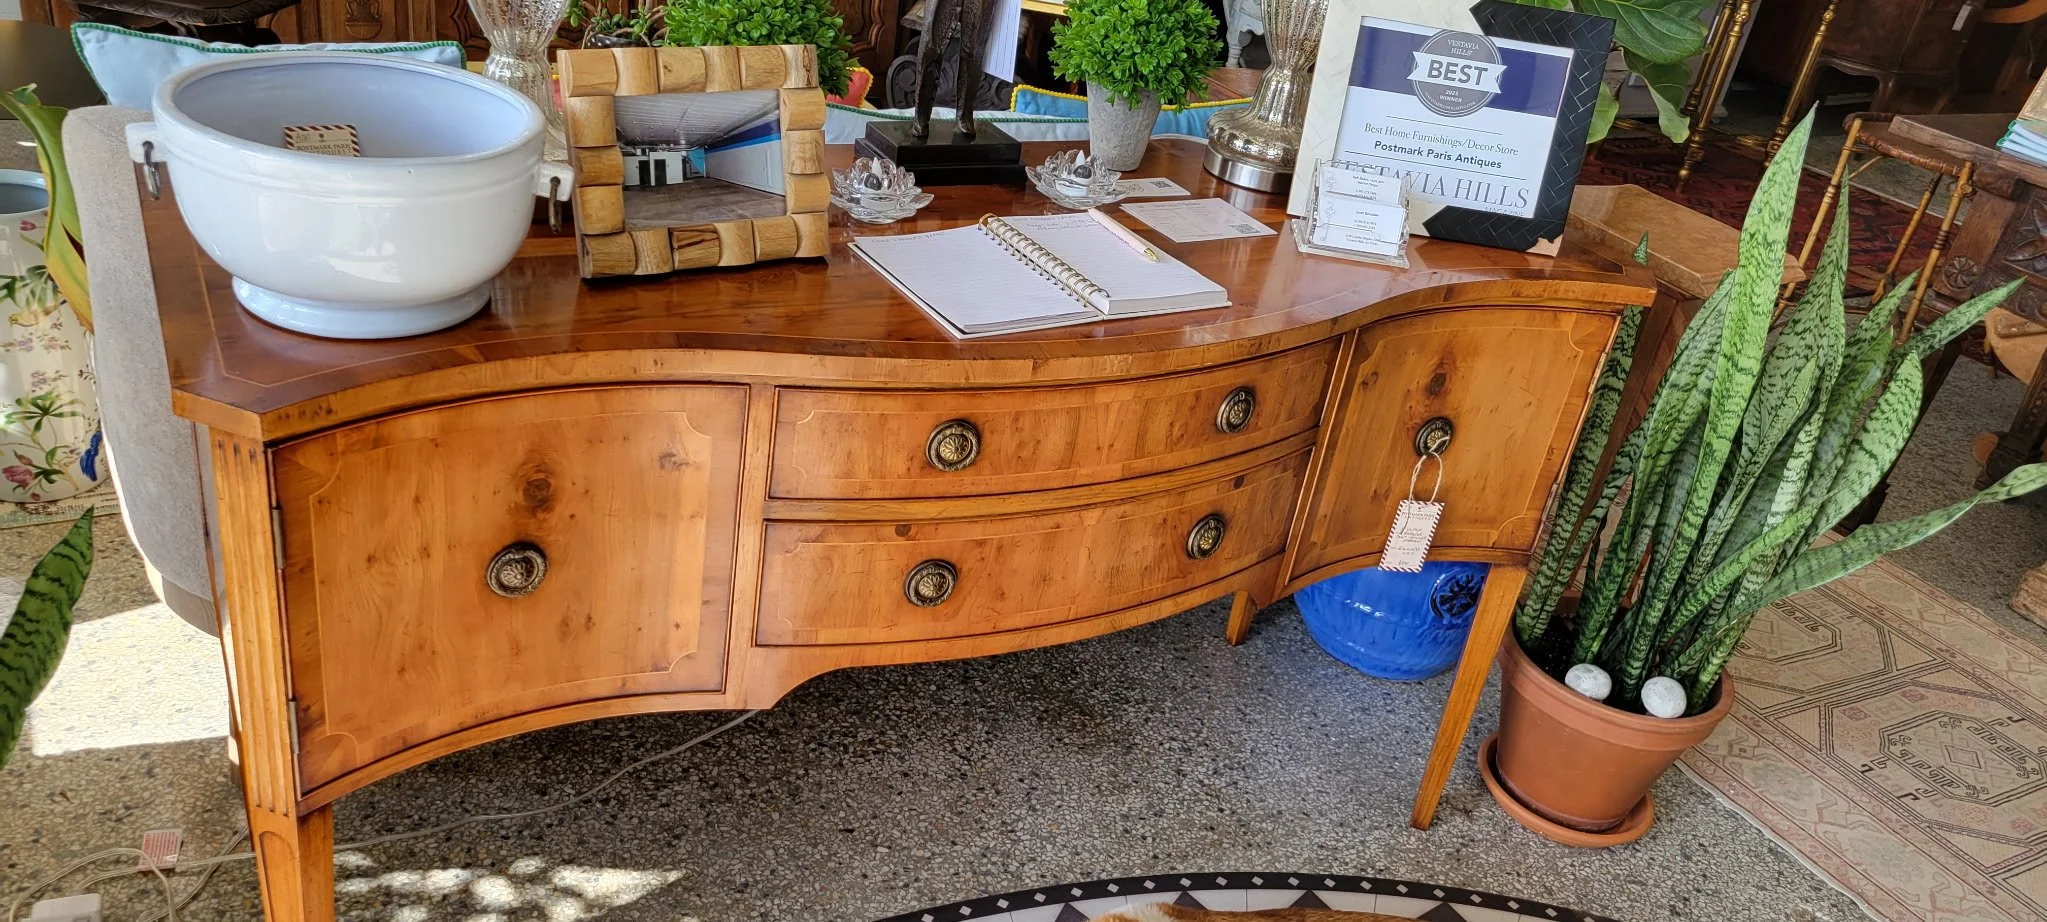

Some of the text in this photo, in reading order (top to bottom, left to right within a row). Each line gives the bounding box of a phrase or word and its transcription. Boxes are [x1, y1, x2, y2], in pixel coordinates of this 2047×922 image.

[1447, 39, 1479, 50] VESTAVIA
[1427, 59, 1489, 86] BEST
[1439, 94, 1463, 103] WINNER
[1364, 122, 1519, 156] Best Home Furnishings/Decor Store
[1374, 140, 1503, 169] Postmark Paris Antiques
[1454, 177, 1530, 209] HILLS
